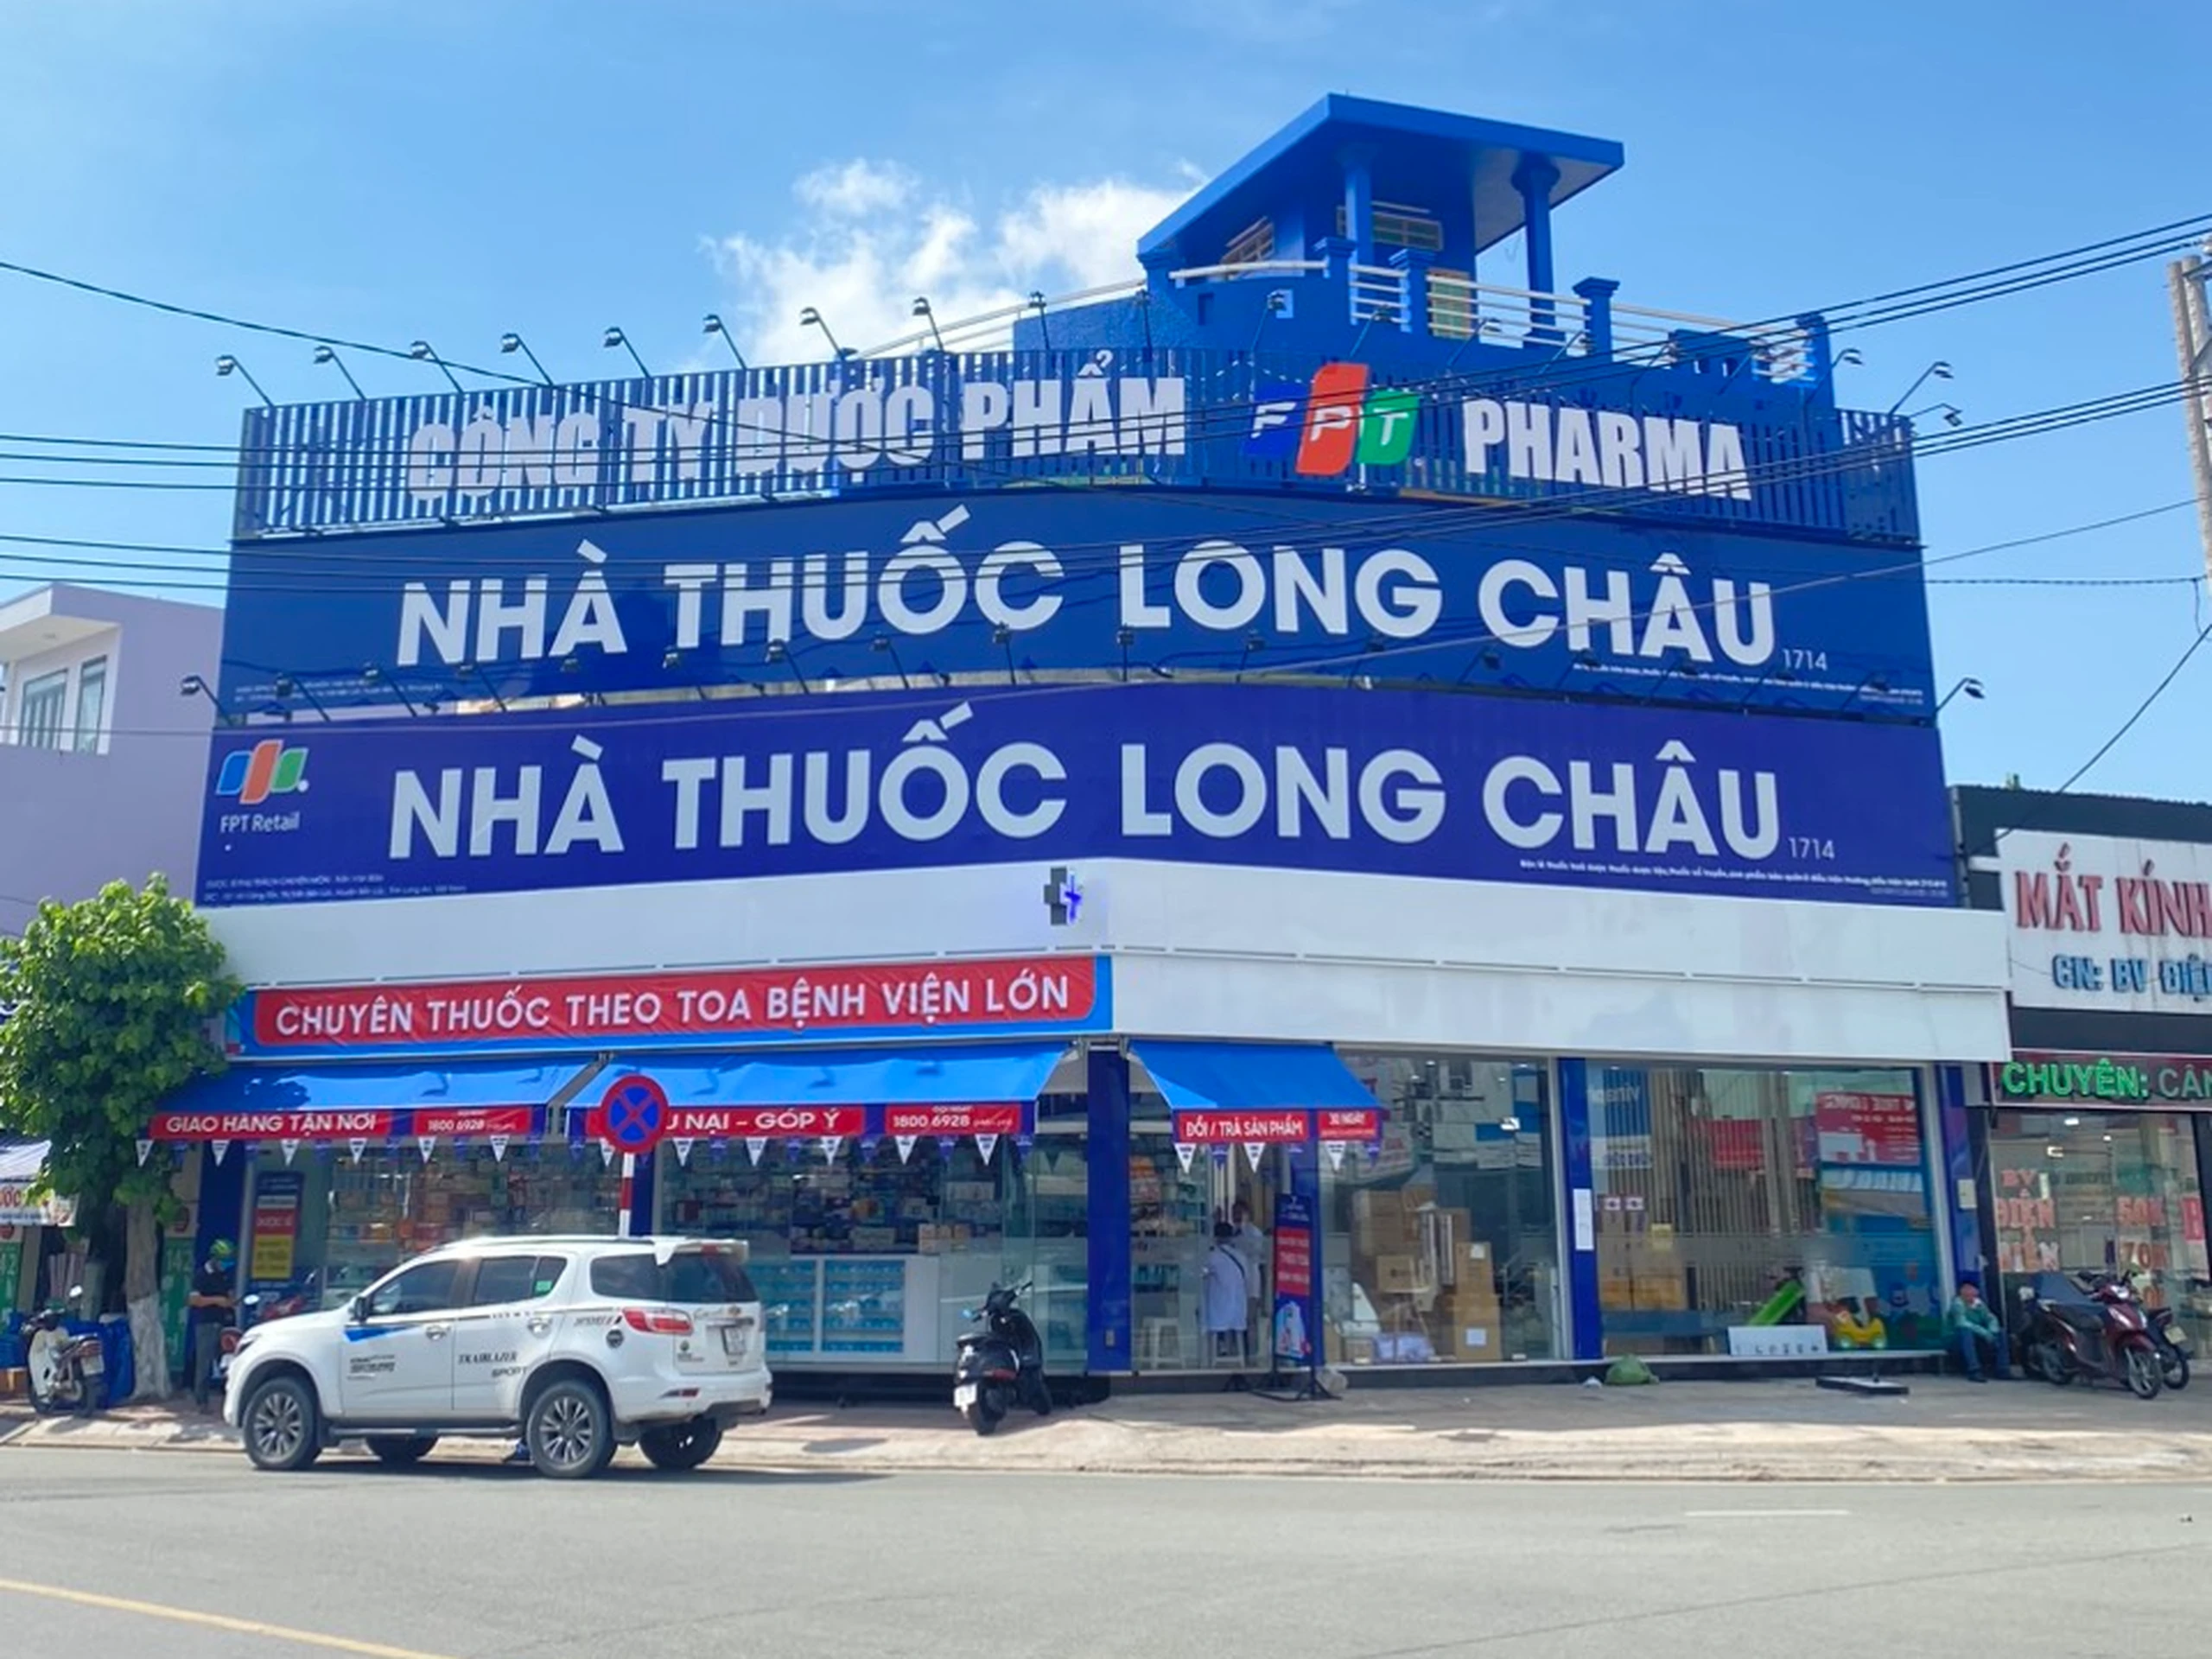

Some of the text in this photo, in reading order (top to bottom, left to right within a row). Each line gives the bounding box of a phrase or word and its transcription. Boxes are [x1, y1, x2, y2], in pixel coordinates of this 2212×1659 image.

[409, 406, 600, 502] CÔNG
[622, 400, 713, 484] TY
[734, 378, 934, 483] DƯỢC
[962, 350, 1185, 460] PHẨM
[1462, 396, 1751, 501] PHARMA
[396, 504, 1827, 673] NHÀ THUỐC LONG CHÂU 1714
[389, 701, 1835, 860] NHÀ THUỐC LONG CHÂU 1714
[220, 810, 301, 833] FPT Retail
[2015, 842, 2212, 938] MẮT KÍNH
[2110, 958, 2149, 993] BV
[276, 968, 1070, 1035] CHUYÊN THUỐC THEO TOA BỆNH VIỆN LỚN
[2001, 1058, 2150, 1100] CHUYÊN:
[166, 1116, 219, 1132] GIAO
[222, 1112, 283, 1132] HÀNG
[289, 1111, 334, 1137] TẬN
[685, 1113, 729, 1135] NẠI
[755, 1108, 816, 1129] GÓP
[823, 1107, 840, 1128] Ý
[931, 1114, 971, 1128] 6928
[1185, 1114, 1209, 1137] ĐỔI
[1218, 1115, 1245, 1136] TRẢ
[1245, 1115, 1268, 1136] SẢN
[1269, 1113, 1303, 1135] PHẨM
